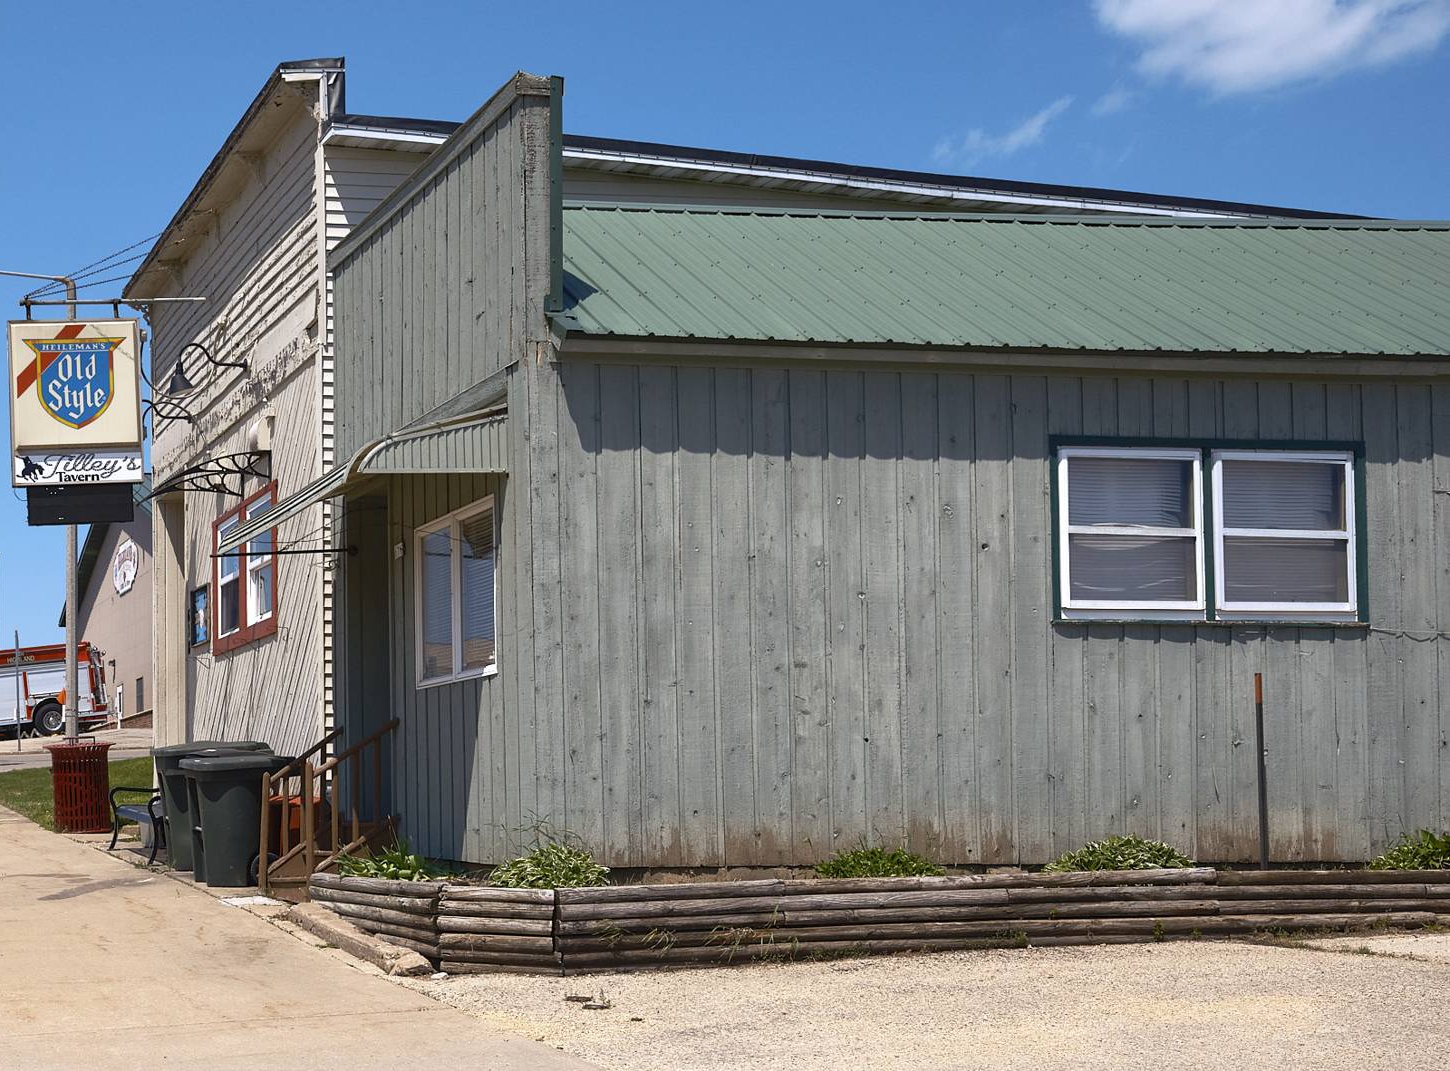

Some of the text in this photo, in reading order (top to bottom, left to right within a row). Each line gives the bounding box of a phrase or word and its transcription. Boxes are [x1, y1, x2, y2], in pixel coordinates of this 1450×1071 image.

[58, 353, 96, 382] Old
[48, 379, 105, 419] Style
[42, 453, 141, 479] Tilley's
[56, 471, 100, 482] Tavern
